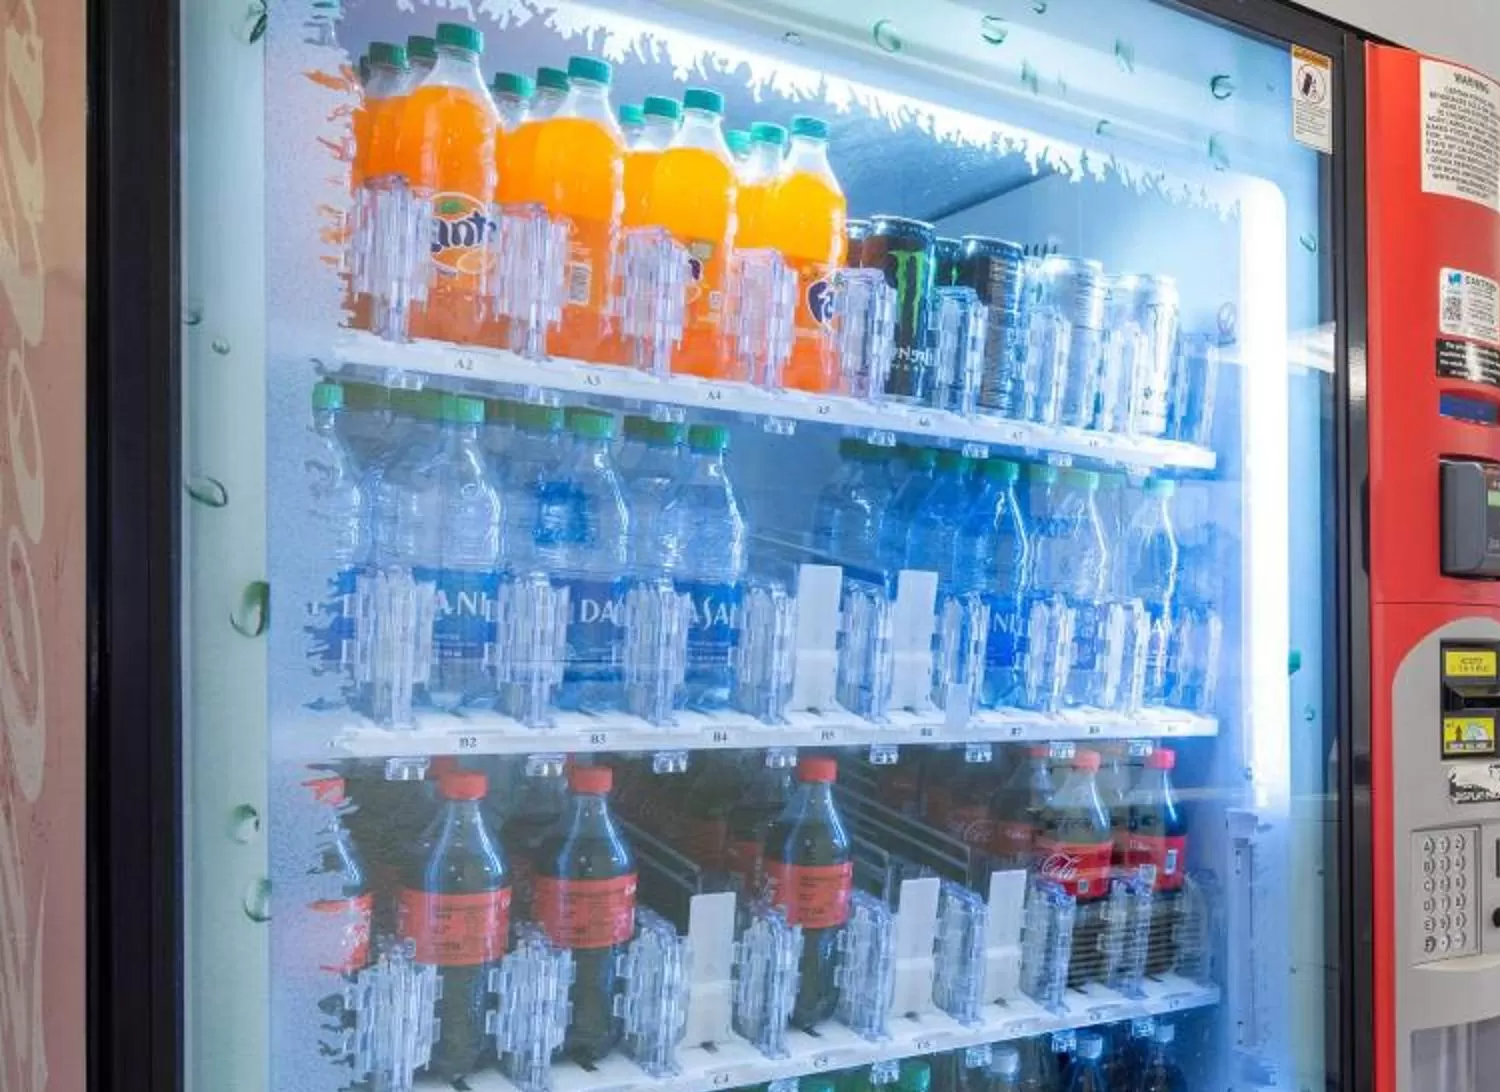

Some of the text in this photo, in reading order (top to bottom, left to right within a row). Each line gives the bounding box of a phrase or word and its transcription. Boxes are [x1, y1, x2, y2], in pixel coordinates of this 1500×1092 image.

[430, 211, 497, 253] ant
[454, 358, 474, 371] A2
[590, 733, 607, 745] B3
[712, 731, 728, 743] B4
